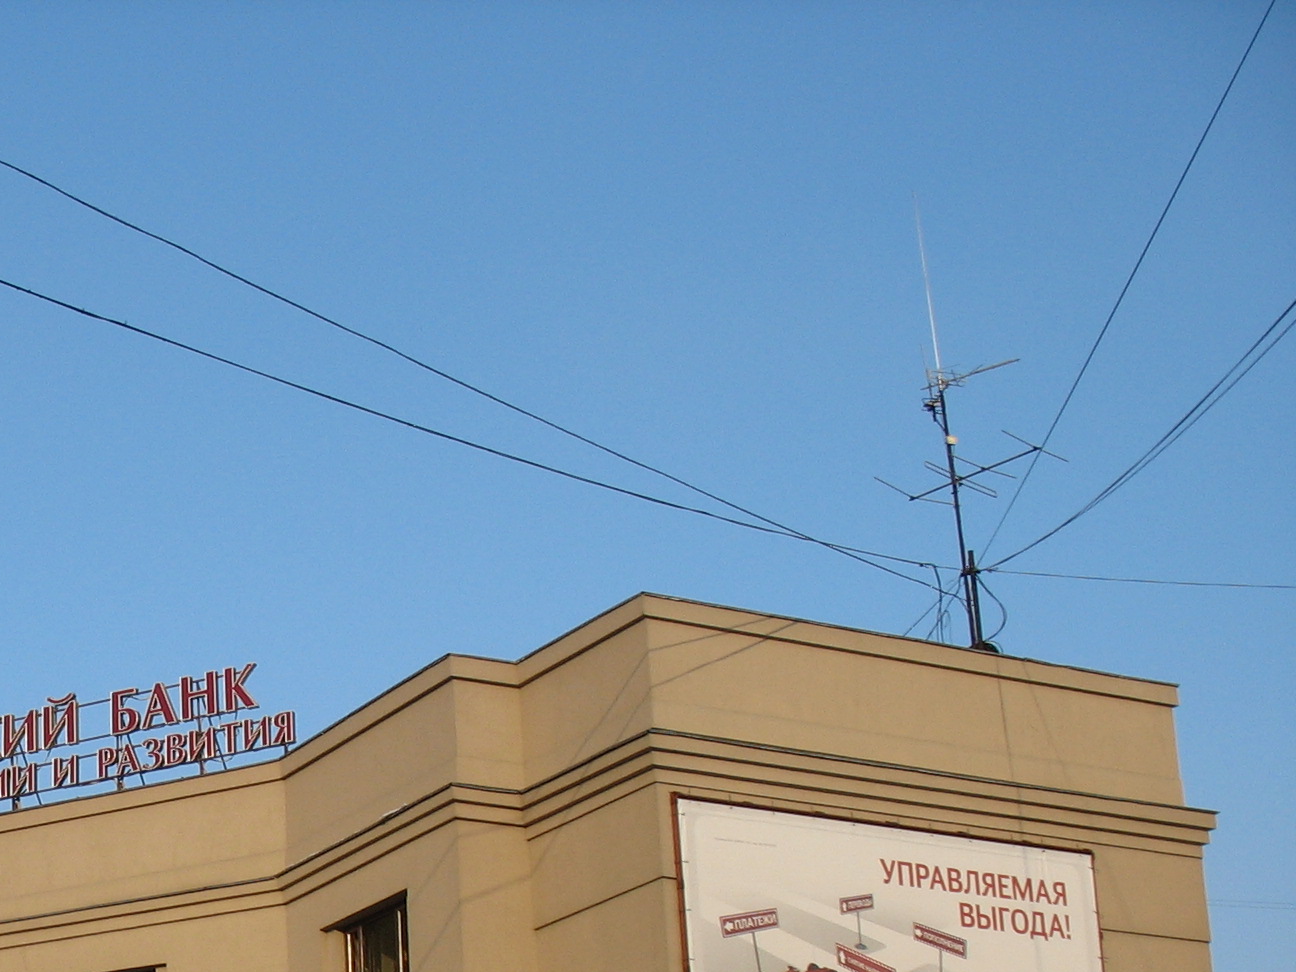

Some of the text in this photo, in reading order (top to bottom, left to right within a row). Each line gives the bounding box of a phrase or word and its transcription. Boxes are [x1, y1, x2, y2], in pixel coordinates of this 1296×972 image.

[110, 662, 259, 737] БАНК
[52, 754, 80, 789] И
[97, 710, 297, 780] РАЗВИТИЯ
[880, 858, 1068, 907] УПРАВЛЯЕМАЯ
[732, 912, 778, 931] ПЛАТЕЖИ
[959, 902, 1072, 941] ВЫГОДА!
